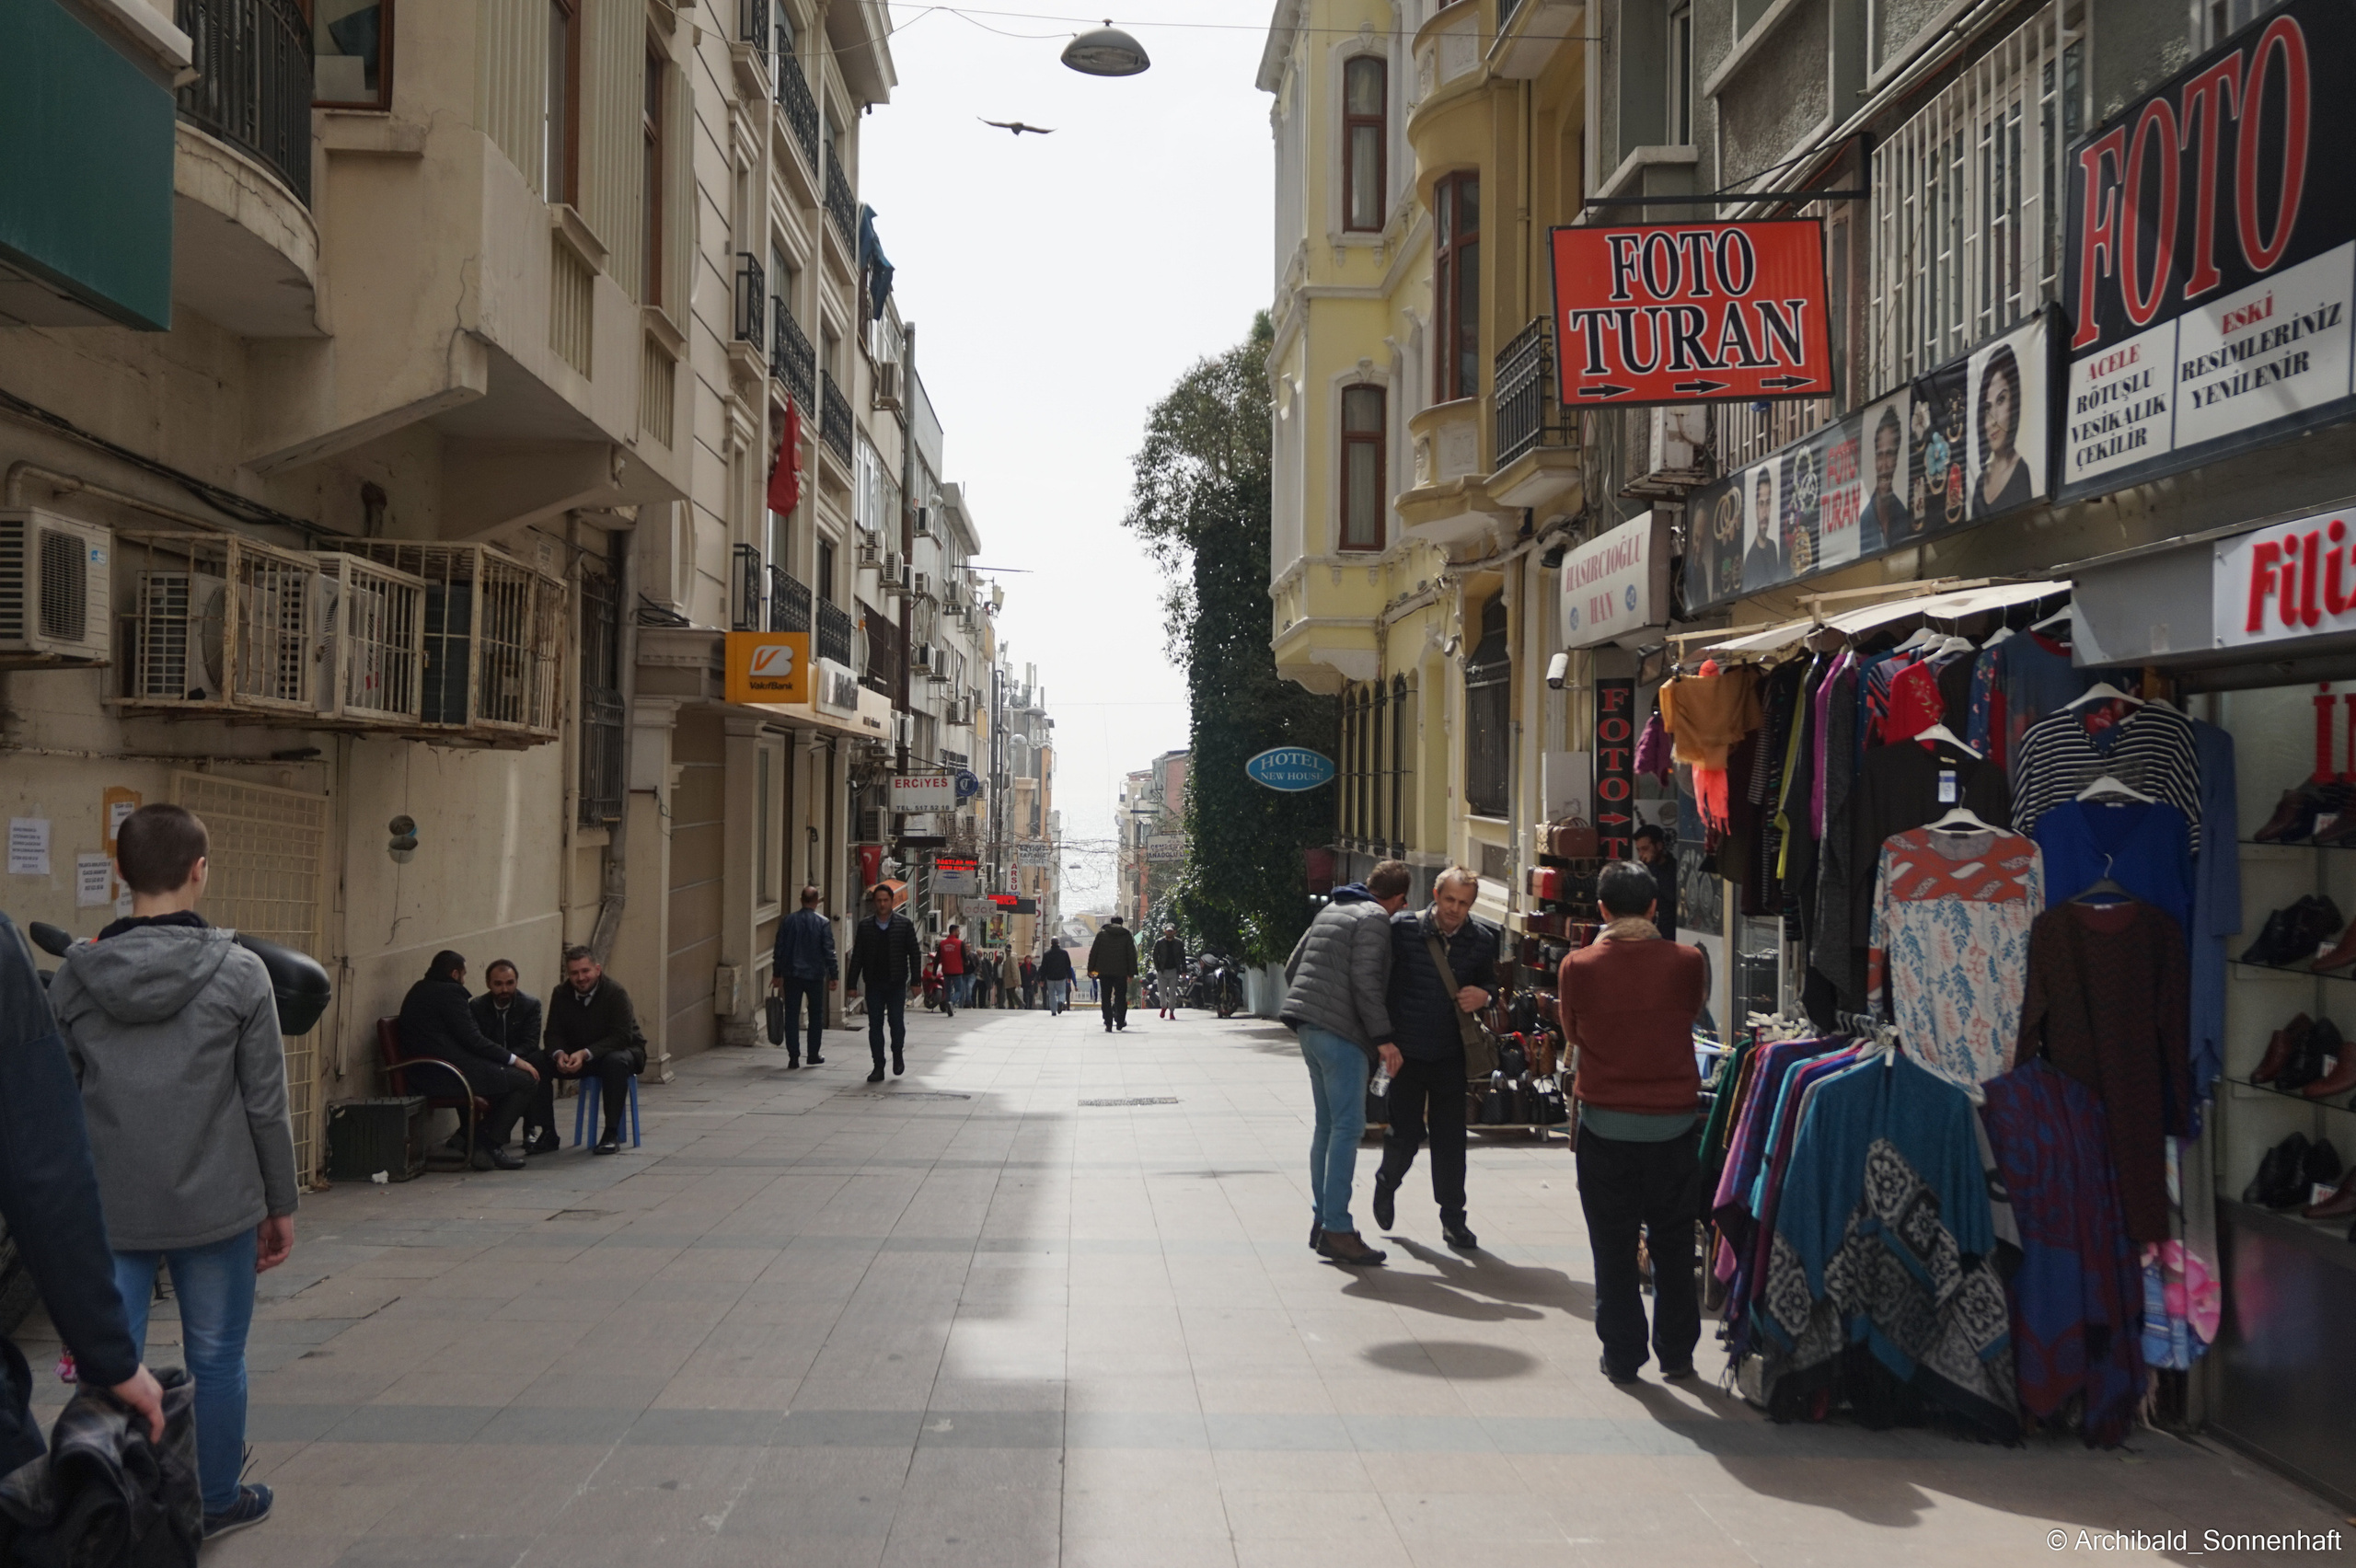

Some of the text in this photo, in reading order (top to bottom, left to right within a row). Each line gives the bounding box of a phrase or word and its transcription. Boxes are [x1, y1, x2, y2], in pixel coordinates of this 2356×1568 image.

[2072, 14, 2311, 351] FOTO
[1605, 227, 1756, 301] FOTO
[1569, 299, 1807, 375] TURAN
[2222, 289, 2274, 335] ESKİ
[2086, 343, 2141, 382] ACELE
[2180, 301, 2343, 383] RESİMLERİNİZ
[2075, 367, 2154, 415] RÖTUŞLU
[2190, 350, 2310, 409] YENİLENİR
[2071, 393, 2167, 444] VESİKALIK
[1827, 437, 1857, 490] FOTO
[2075, 424, 2148, 471] ÇEKİLİR
[1820, 479, 1861, 535] TURAN
[1566, 532, 1644, 593] HASIRCIOĞLU
[1590, 590, 1614, 625] HAN
[1260, 753, 1324, 771] HOTEL
[1599, 688, 1631, 801] FOTO
[1260, 772, 1324, 780] NEW HOUSE
